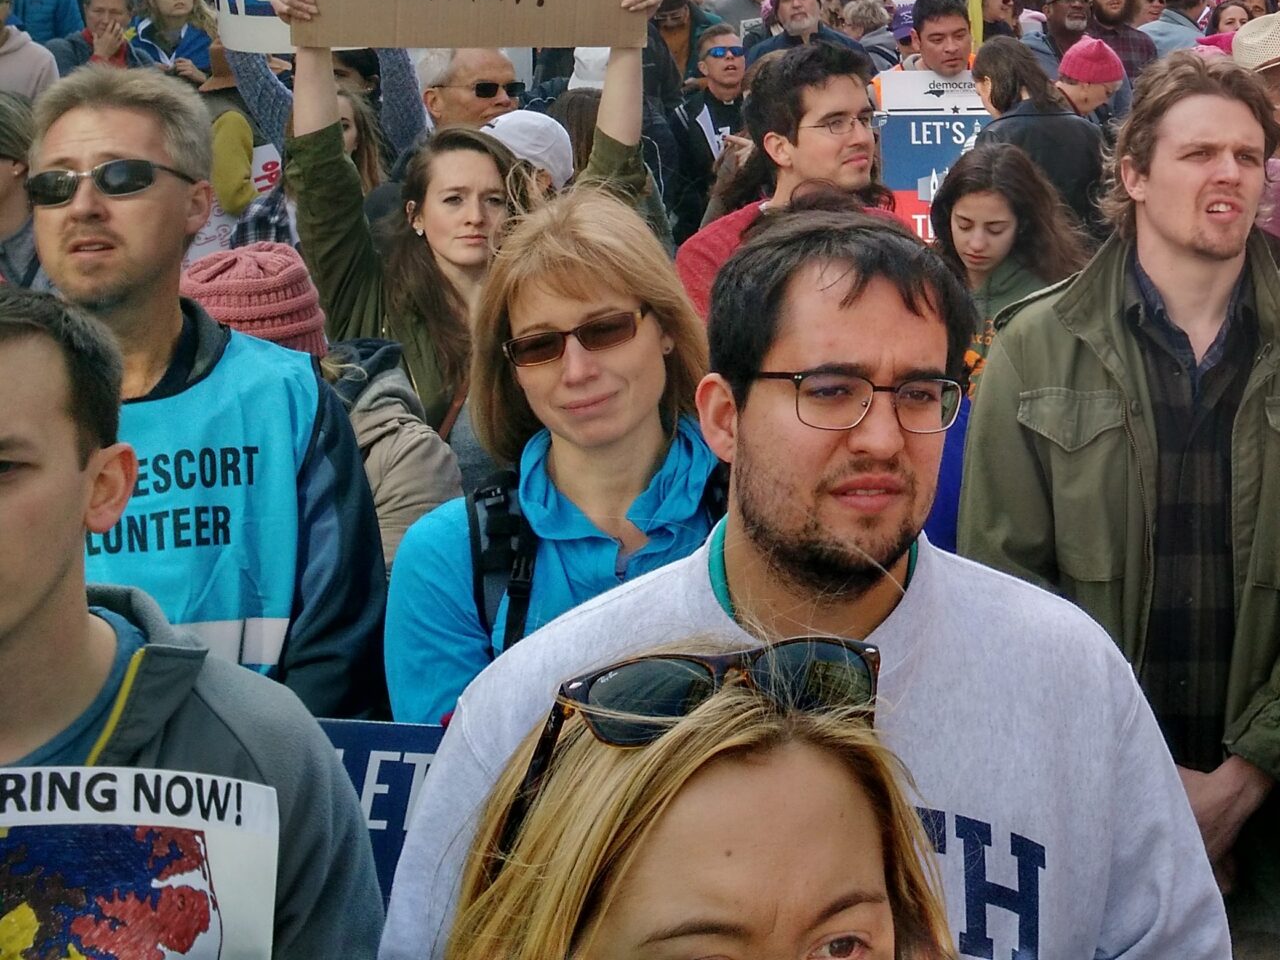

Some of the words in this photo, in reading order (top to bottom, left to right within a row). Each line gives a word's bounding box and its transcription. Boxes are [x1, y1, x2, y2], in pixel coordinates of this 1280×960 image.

[911, 121, 966, 145] LET'S
[0, 771, 117, 813] RING
[133, 773, 242, 826] NOW!
